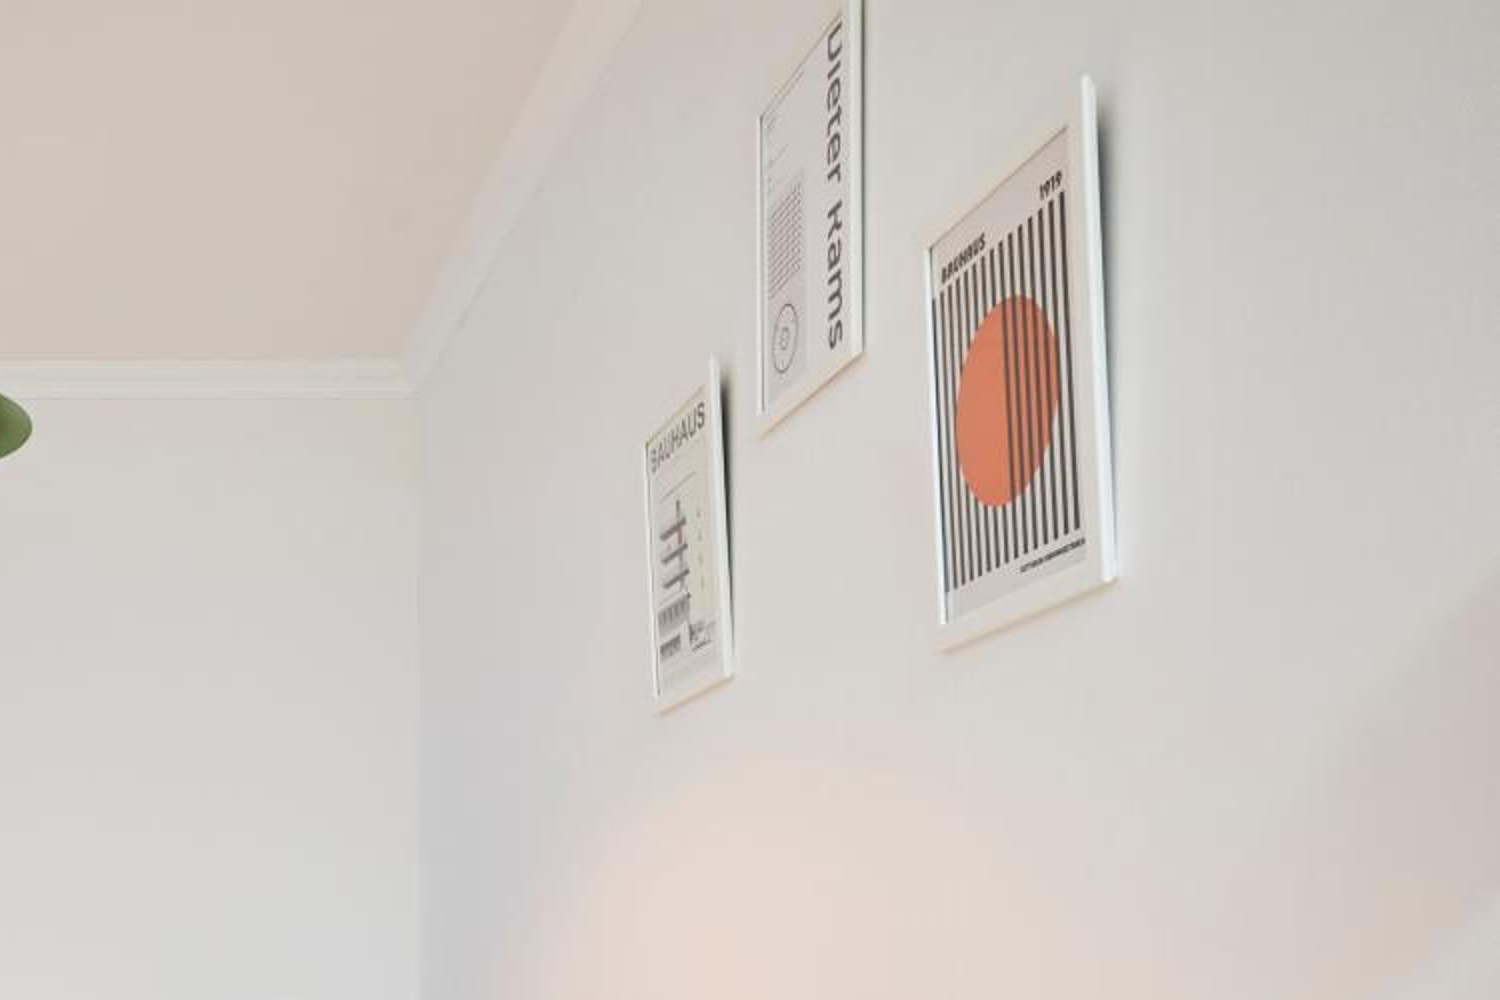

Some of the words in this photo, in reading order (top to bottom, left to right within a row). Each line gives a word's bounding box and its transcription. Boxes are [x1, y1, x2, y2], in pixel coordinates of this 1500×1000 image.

[1040, 169, 1062, 200] 1919
[942, 232, 985, 284] BAUHAUS
[649, 402, 705, 475] BAUHAUS
